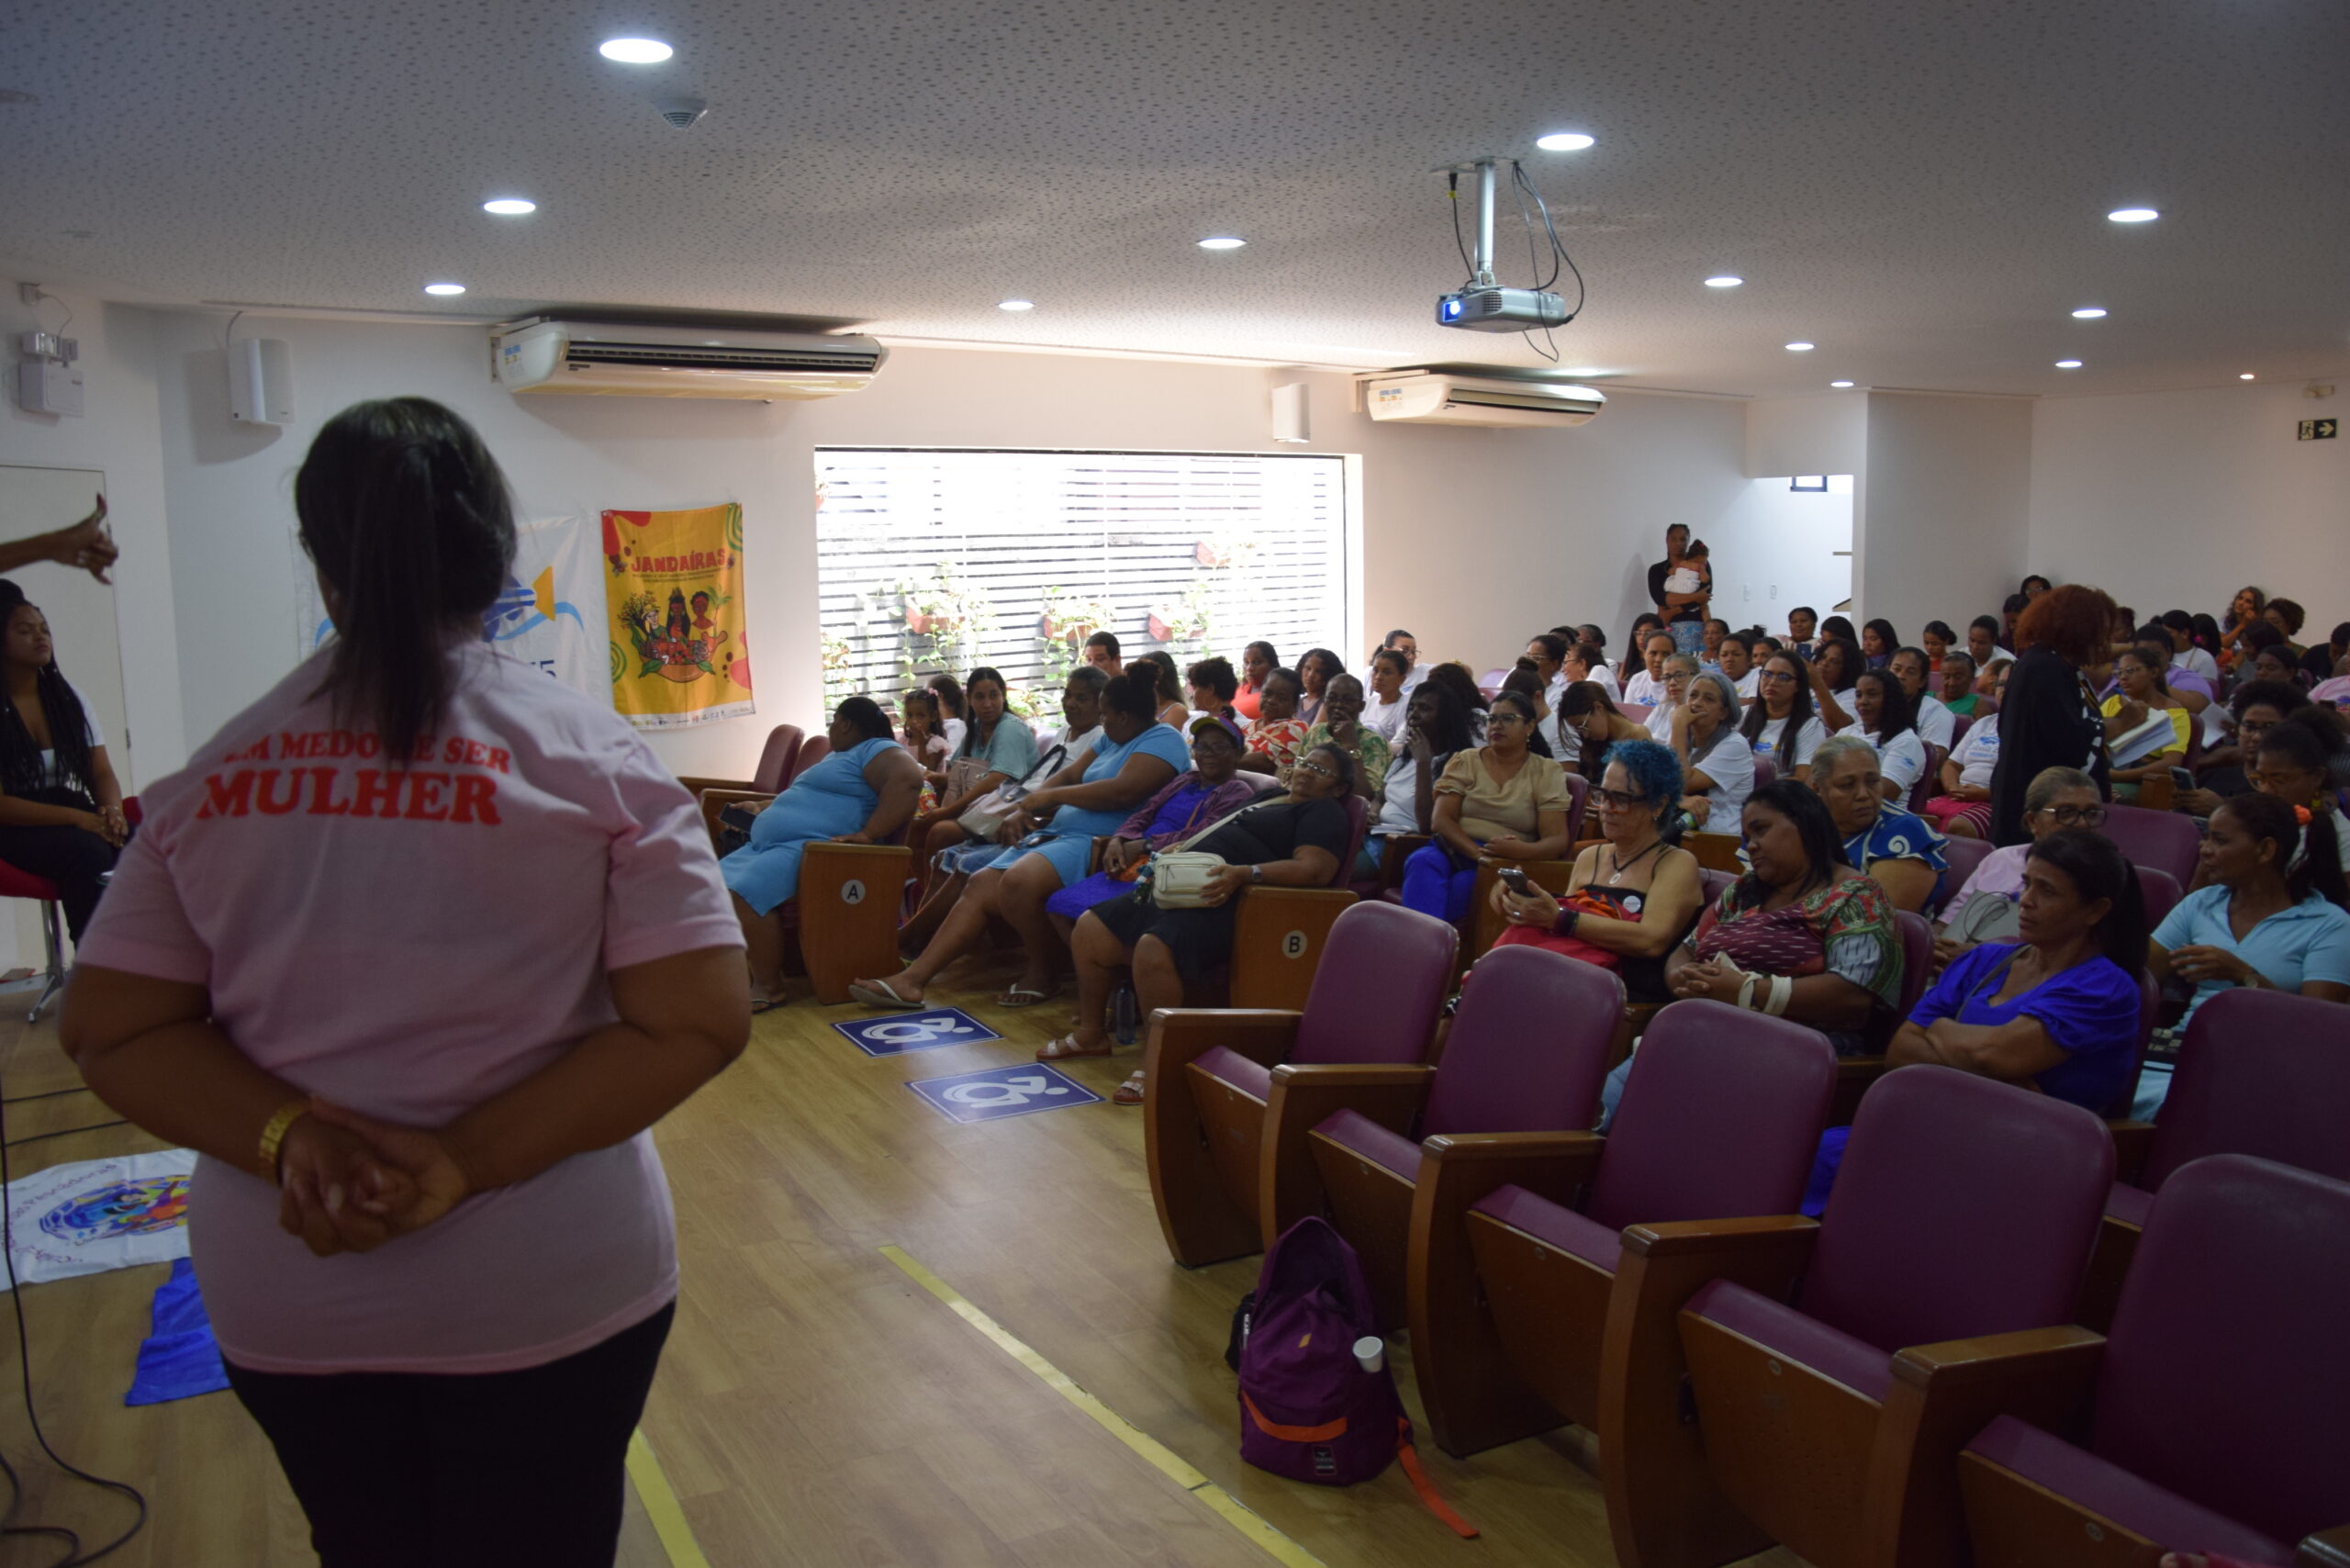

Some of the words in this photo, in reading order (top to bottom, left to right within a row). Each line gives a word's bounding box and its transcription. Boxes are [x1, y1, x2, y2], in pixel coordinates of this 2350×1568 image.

[632, 548, 725, 572] JANDAÍRAS
[279, 730, 381, 759] MEDO
[443, 736, 510, 774] SER
[196, 767, 502, 825] MULHER
[846, 884, 859, 900] A
[1289, 935, 1301, 953] B
